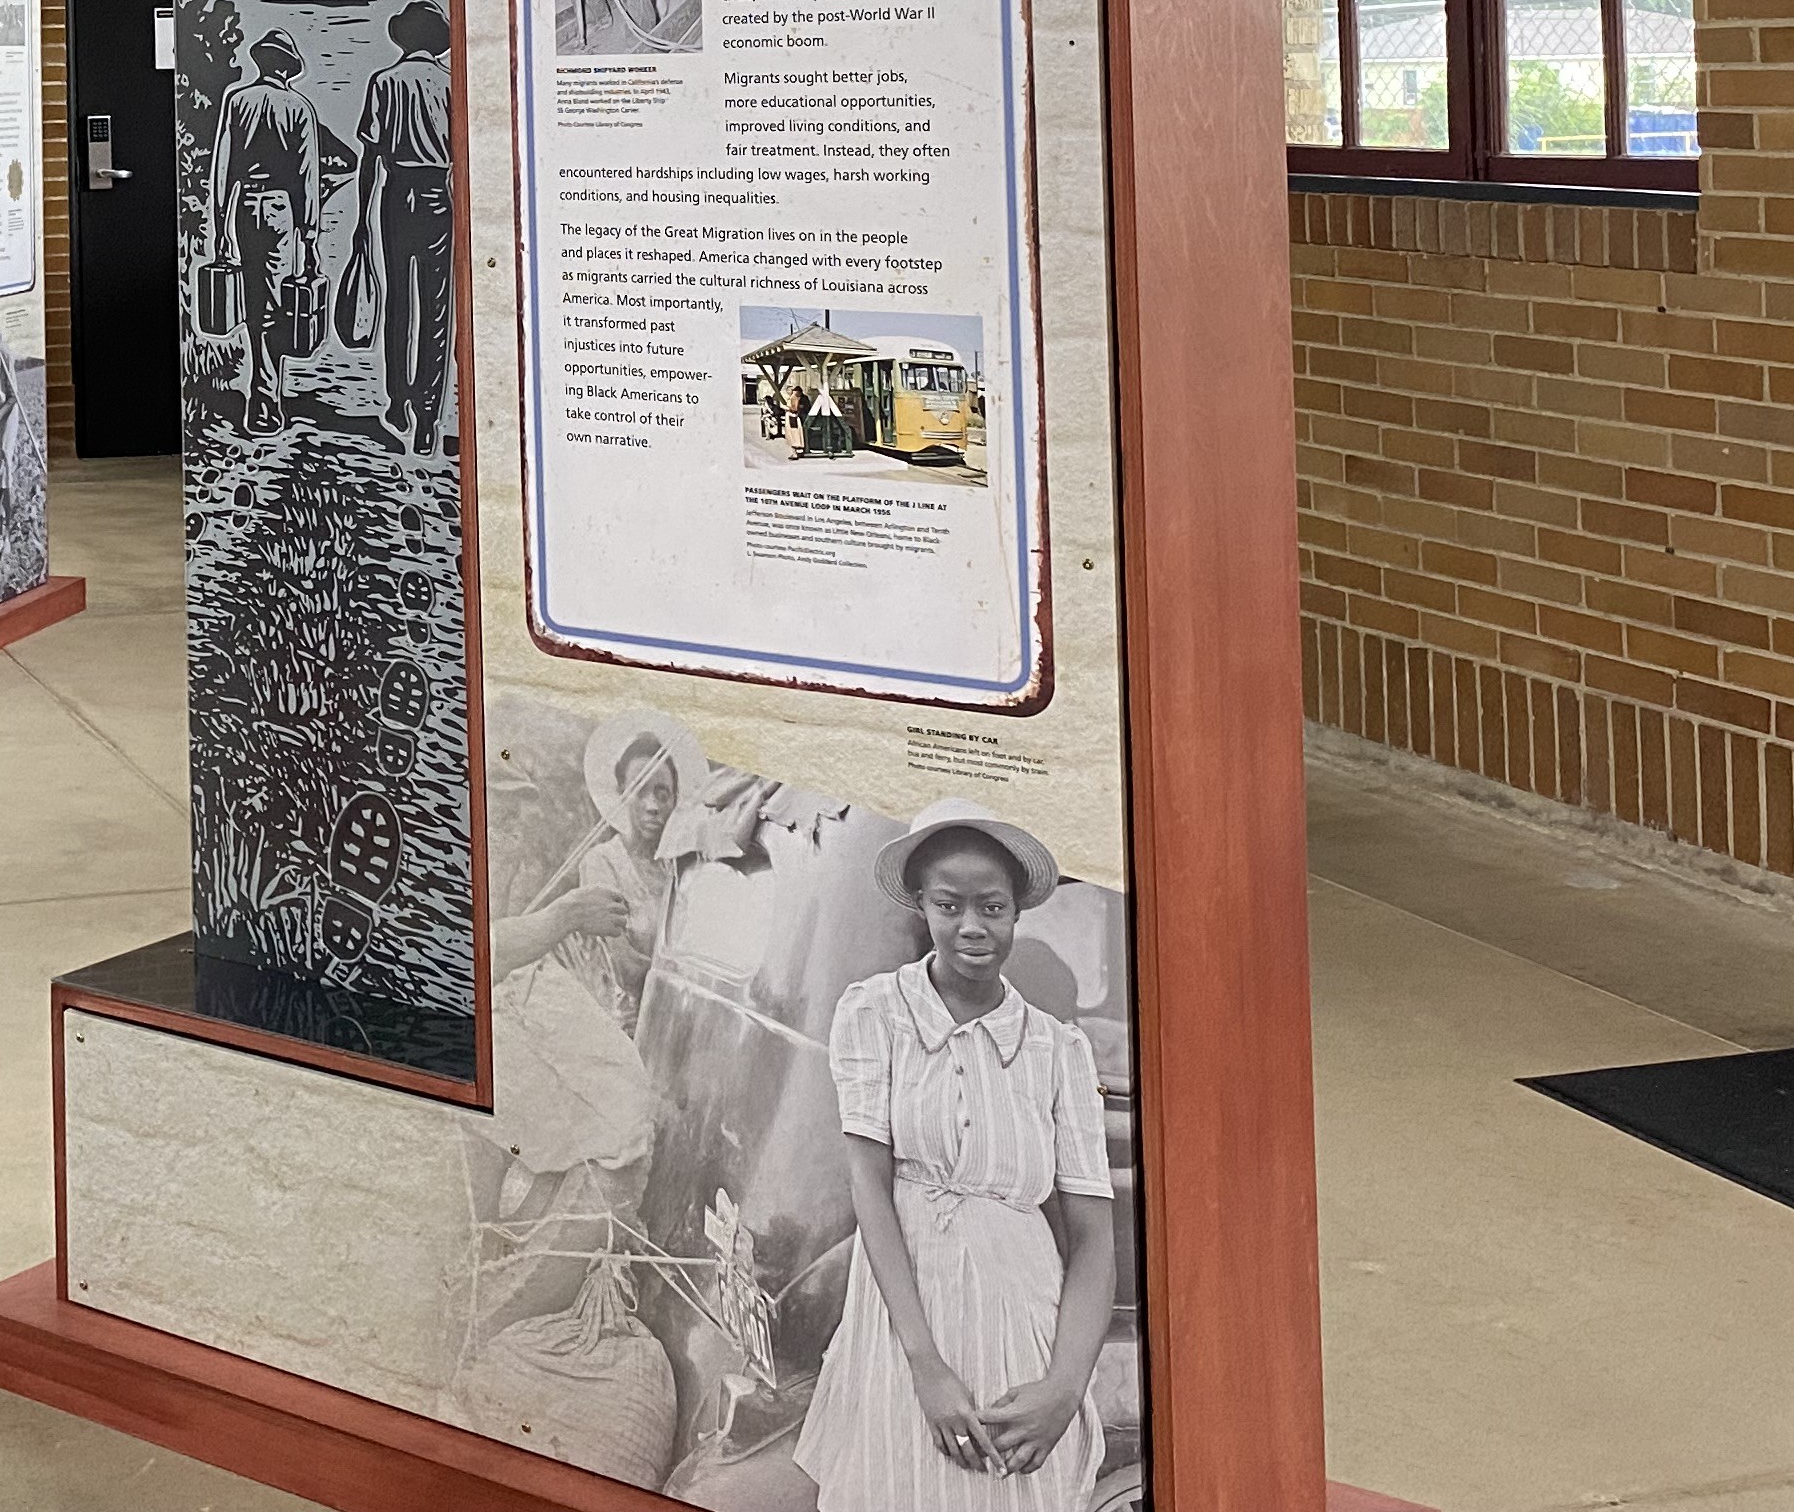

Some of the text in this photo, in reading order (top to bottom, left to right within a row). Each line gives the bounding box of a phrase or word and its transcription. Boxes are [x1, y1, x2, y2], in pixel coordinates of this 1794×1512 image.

[724, 69, 908, 87] Migrants sought better jobs,
[724, 93, 935, 110] more educational opportunities,
[725, 119, 930, 135] improved living conditions, and
[725, 143, 950, 160] fair treatment. Instead, they often
[559, 166, 930, 185] encountered hardships including low wages, harsh working
[559, 188, 779, 205] conditions, and housing inequalities.
[563, 315, 675, 333] it transformed past
[564, 337, 684, 355] injustices into future
[564, 363, 712, 381] opportunities, empower-
[565, 383, 699, 404] ing Black Americans to
[564, 406, 685, 426] take control of their
[566, 432, 651, 447] own narrative.
[744, 486, 791, 496] PASSENGERS
[826, 493, 840, 501] THE
[842, 495, 882, 504] PLATFORM
[842, 505, 871, 513] MARCH
[906, 726, 925, 734] GIRL
[926, 728, 967, 740] STANDING
[981, 736, 999, 745] CAR
